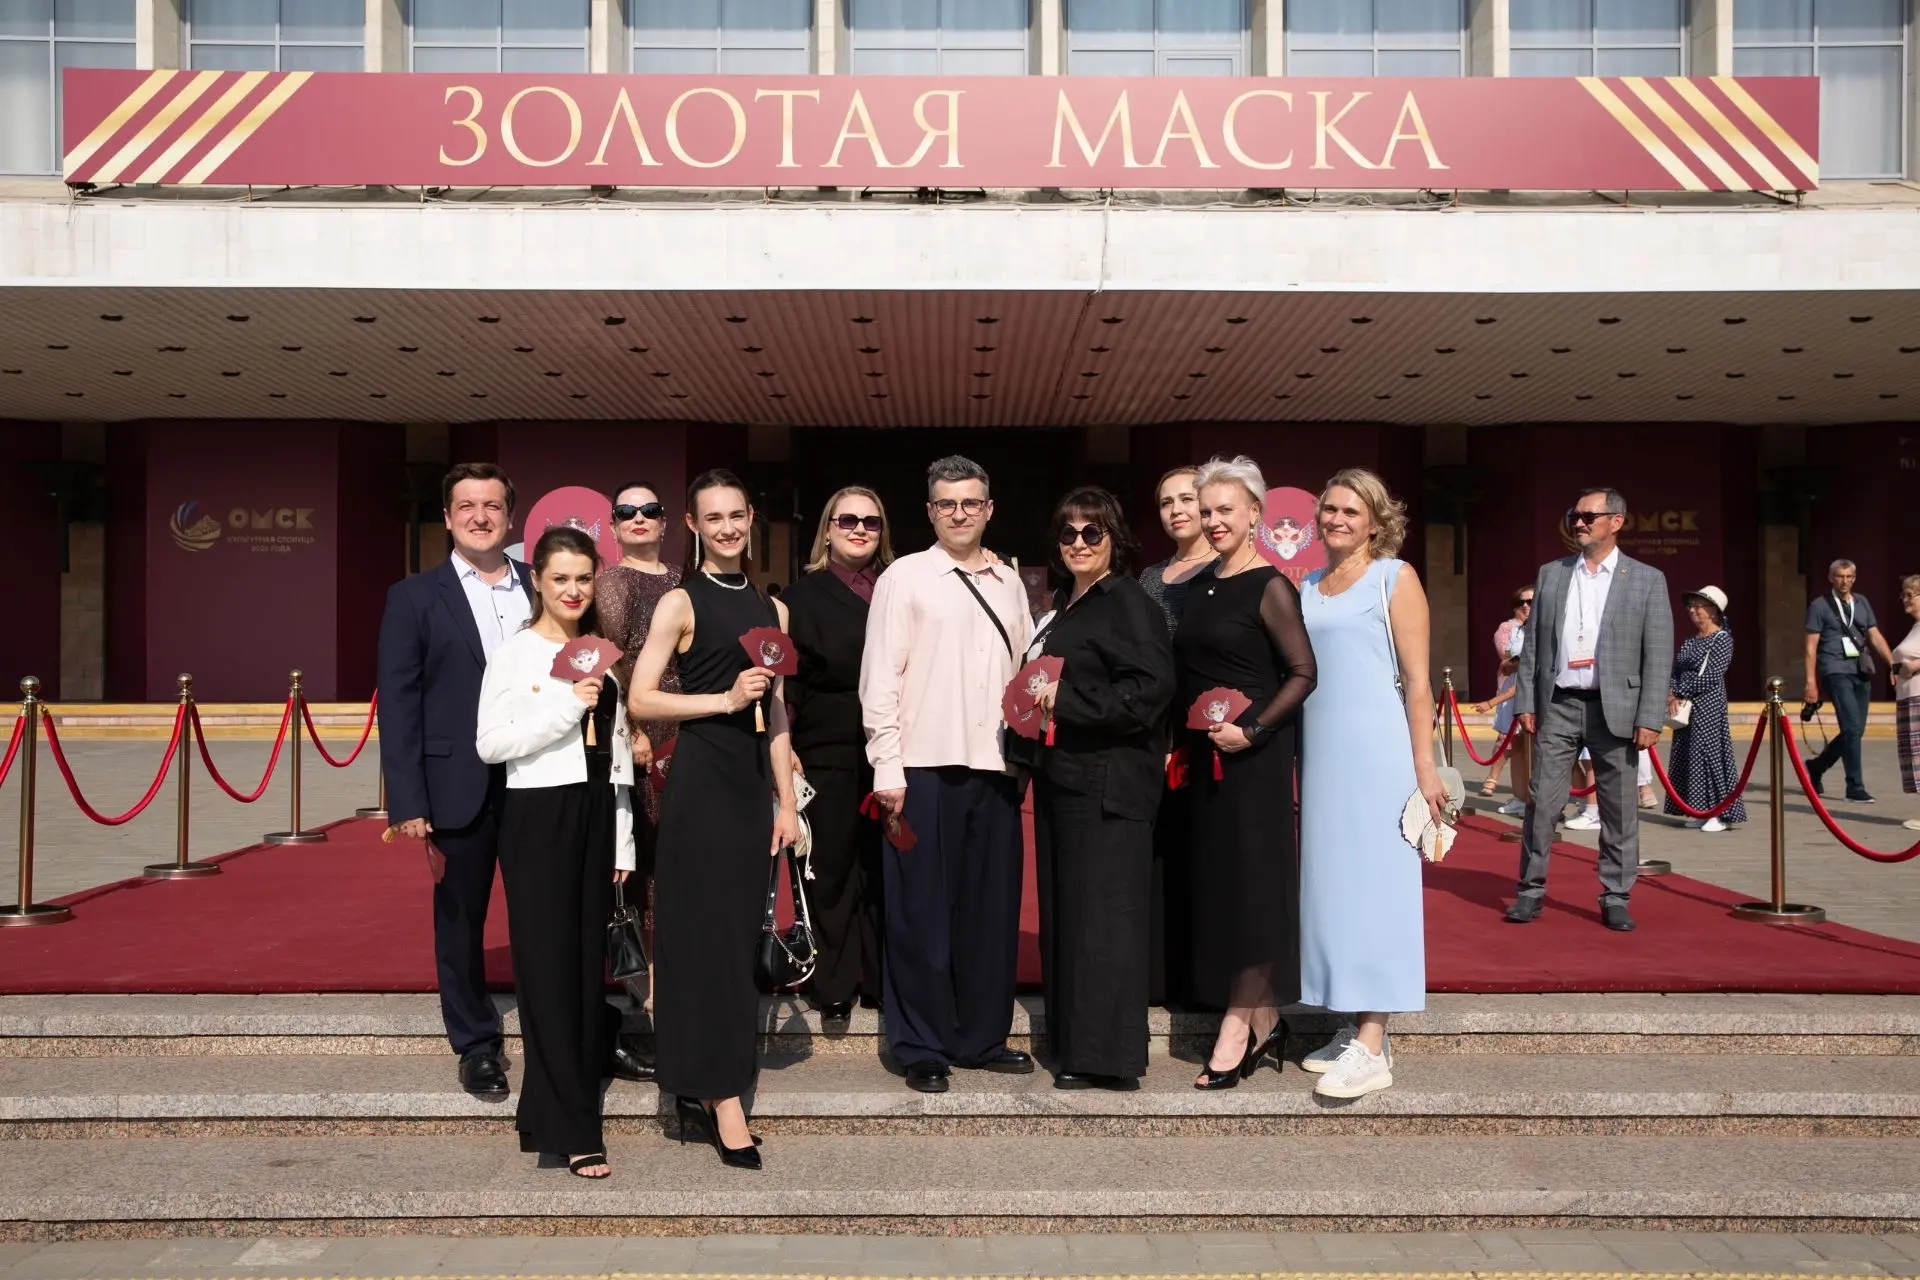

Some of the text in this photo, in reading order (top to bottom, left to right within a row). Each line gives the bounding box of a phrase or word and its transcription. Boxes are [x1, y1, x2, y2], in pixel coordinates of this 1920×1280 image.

[439, 86, 1450, 171] ЗОЛОТАЯ МАСКА
[228, 508, 315, 529] ОМСК
[277, 536, 315, 544] СТОЛИЦА
